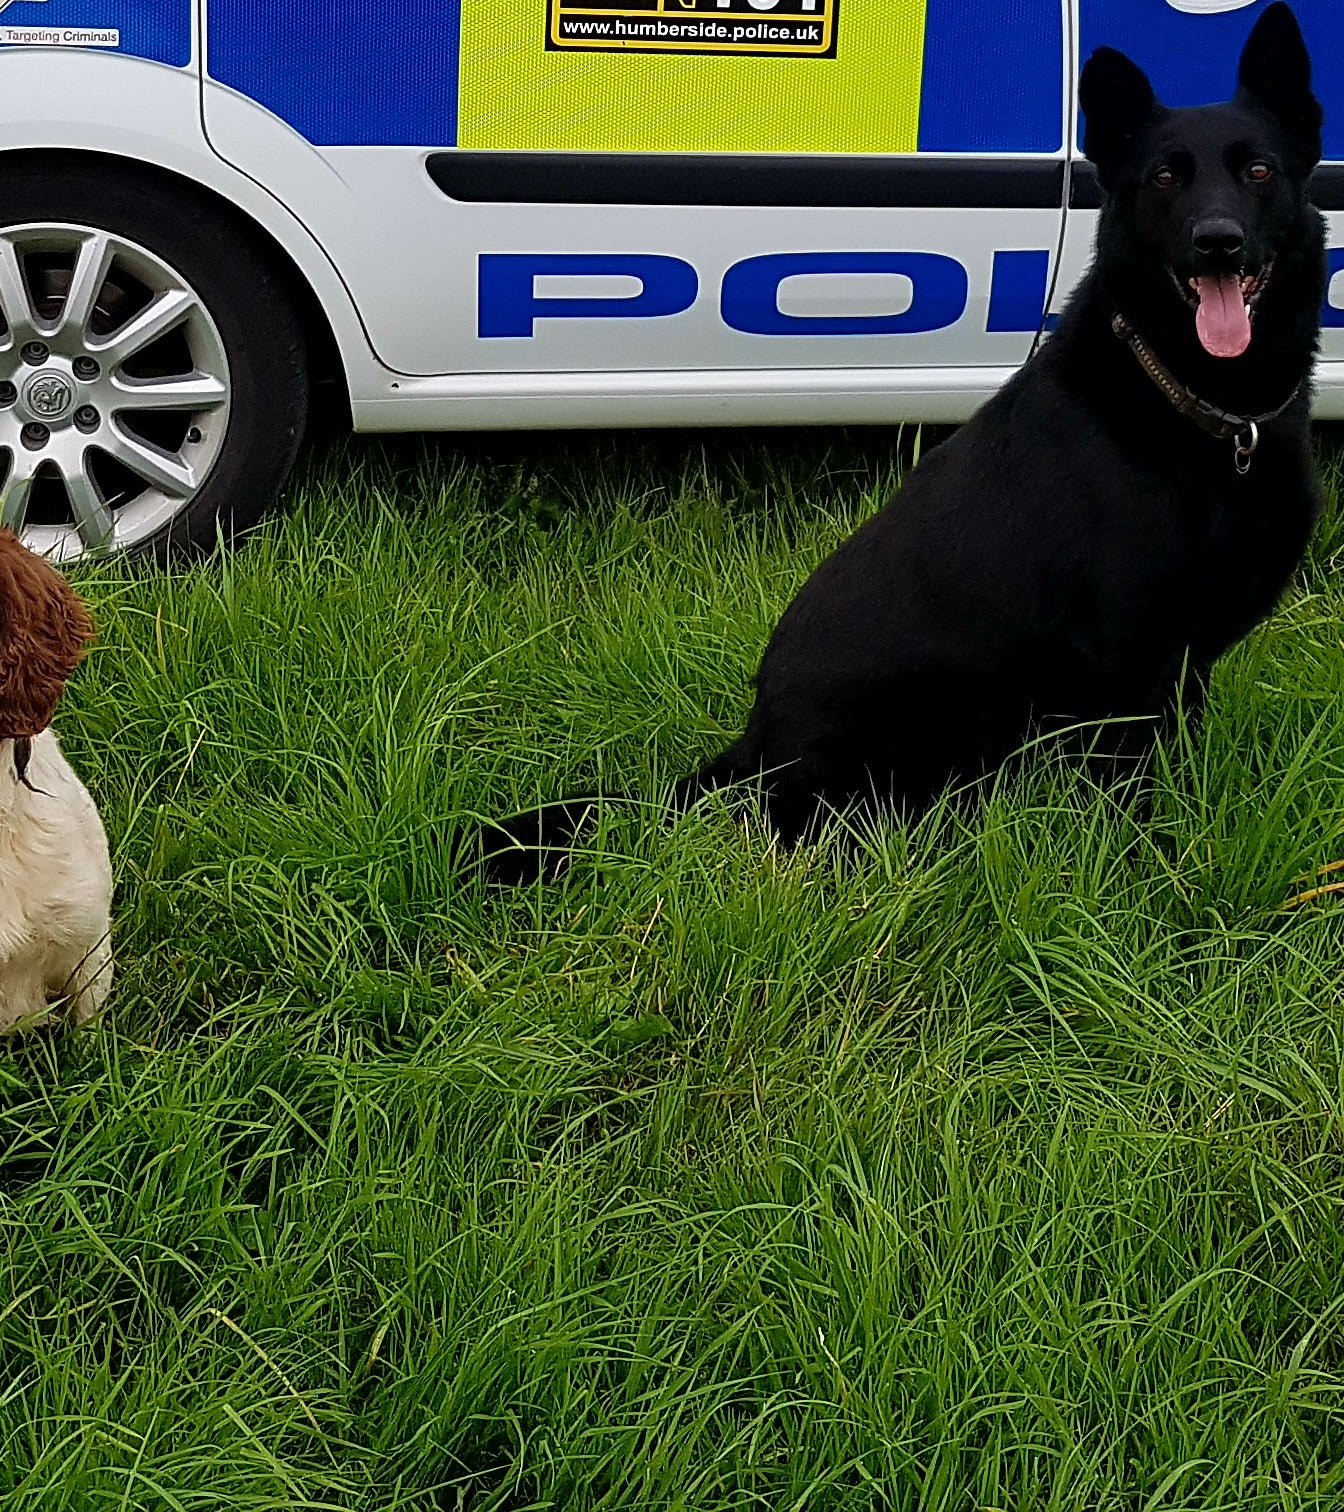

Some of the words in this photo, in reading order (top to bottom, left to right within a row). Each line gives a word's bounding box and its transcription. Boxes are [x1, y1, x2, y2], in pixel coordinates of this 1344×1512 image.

[7, 30, 60, 43] Targeting
[63, 31, 117, 43] Criminals
[563, 20, 819, 41] www.humberside.police.uk
